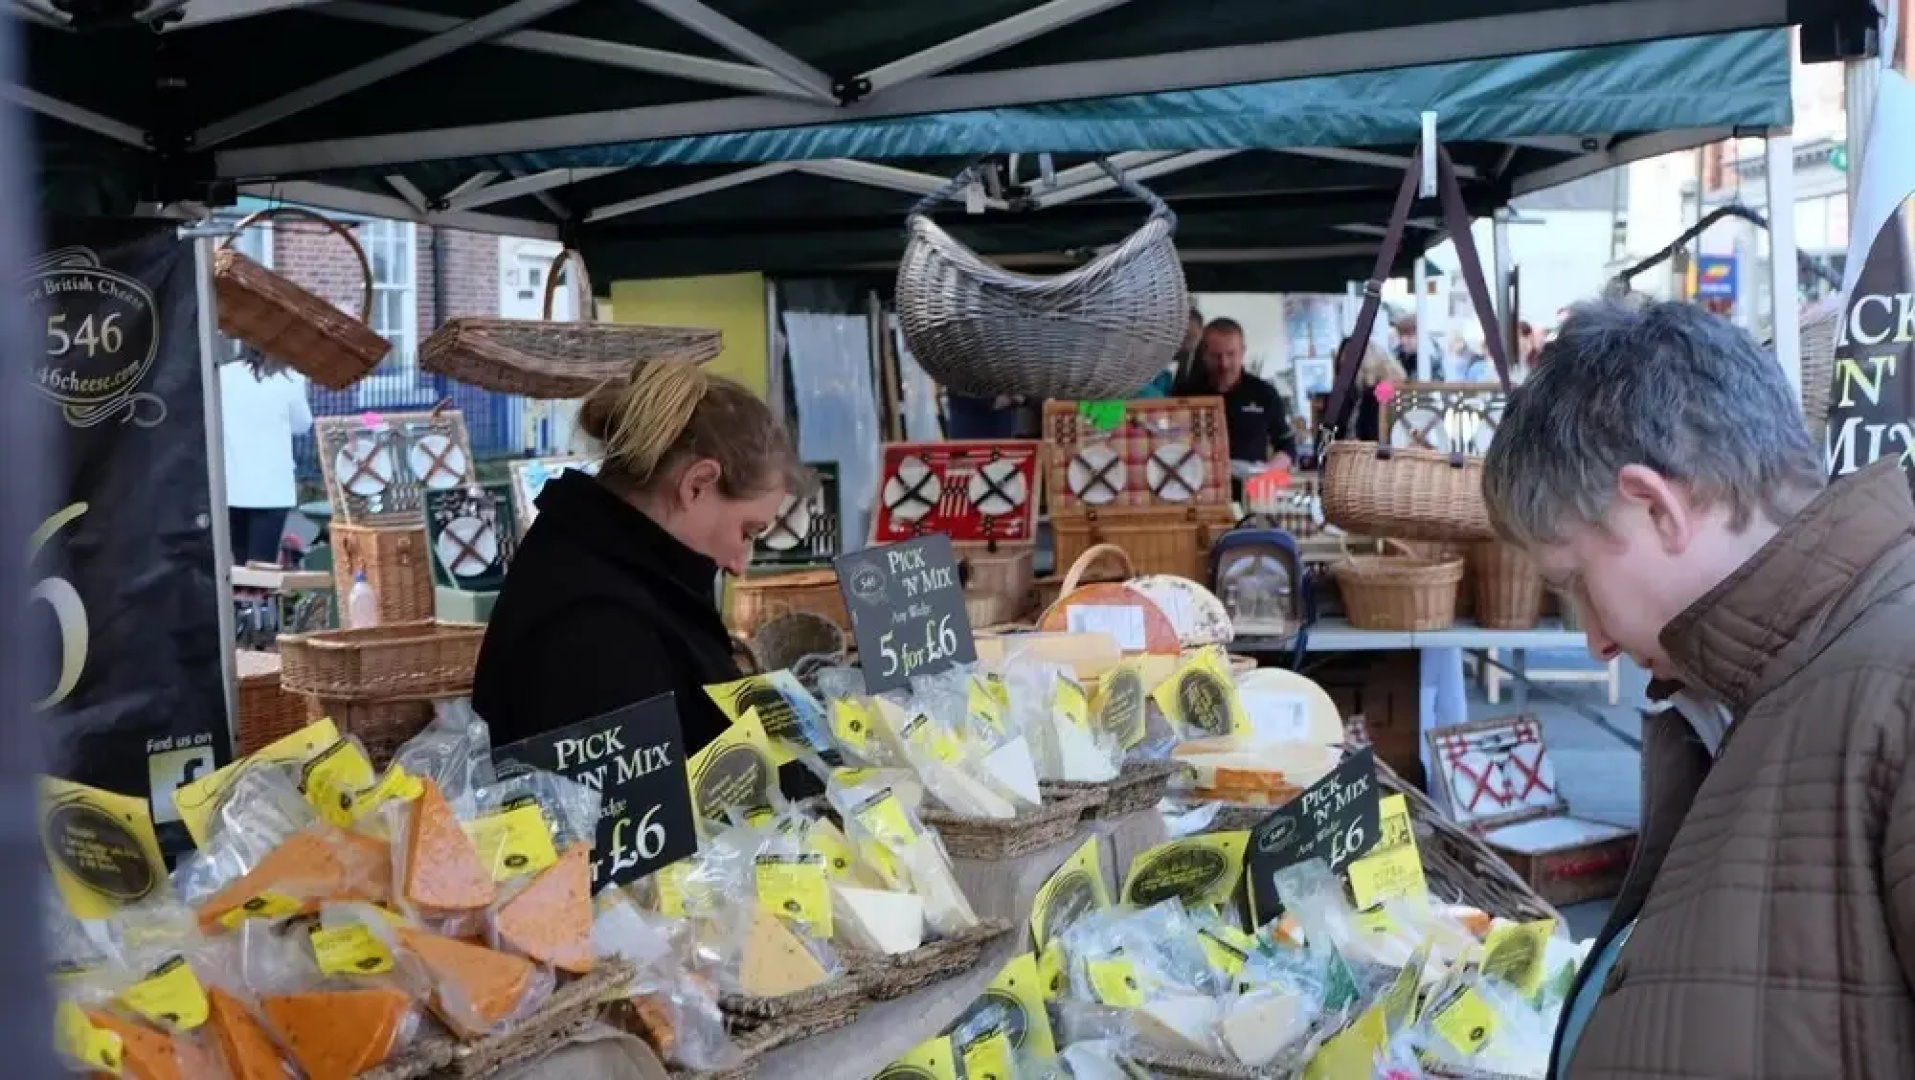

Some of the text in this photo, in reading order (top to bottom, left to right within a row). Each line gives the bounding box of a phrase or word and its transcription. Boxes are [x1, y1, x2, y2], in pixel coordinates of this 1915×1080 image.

[44, 276, 93, 295] British
[46, 312, 124, 359] 546
[1837, 292, 1915, 347] ICK
[887, 548, 926, 575] PICK
[920, 566, 953, 593] MIX
[880, 614, 957, 677] 5 for £6
[146, 731, 213, 753] Find us on
[553, 725, 626, 771] PICK
[613, 741, 674, 785] MIX
[1302, 774, 1344, 815] PICK
[1335, 773, 1370, 813] MIX
[609, 803, 666, 876] £6
[1330, 814, 1365, 870] £6
